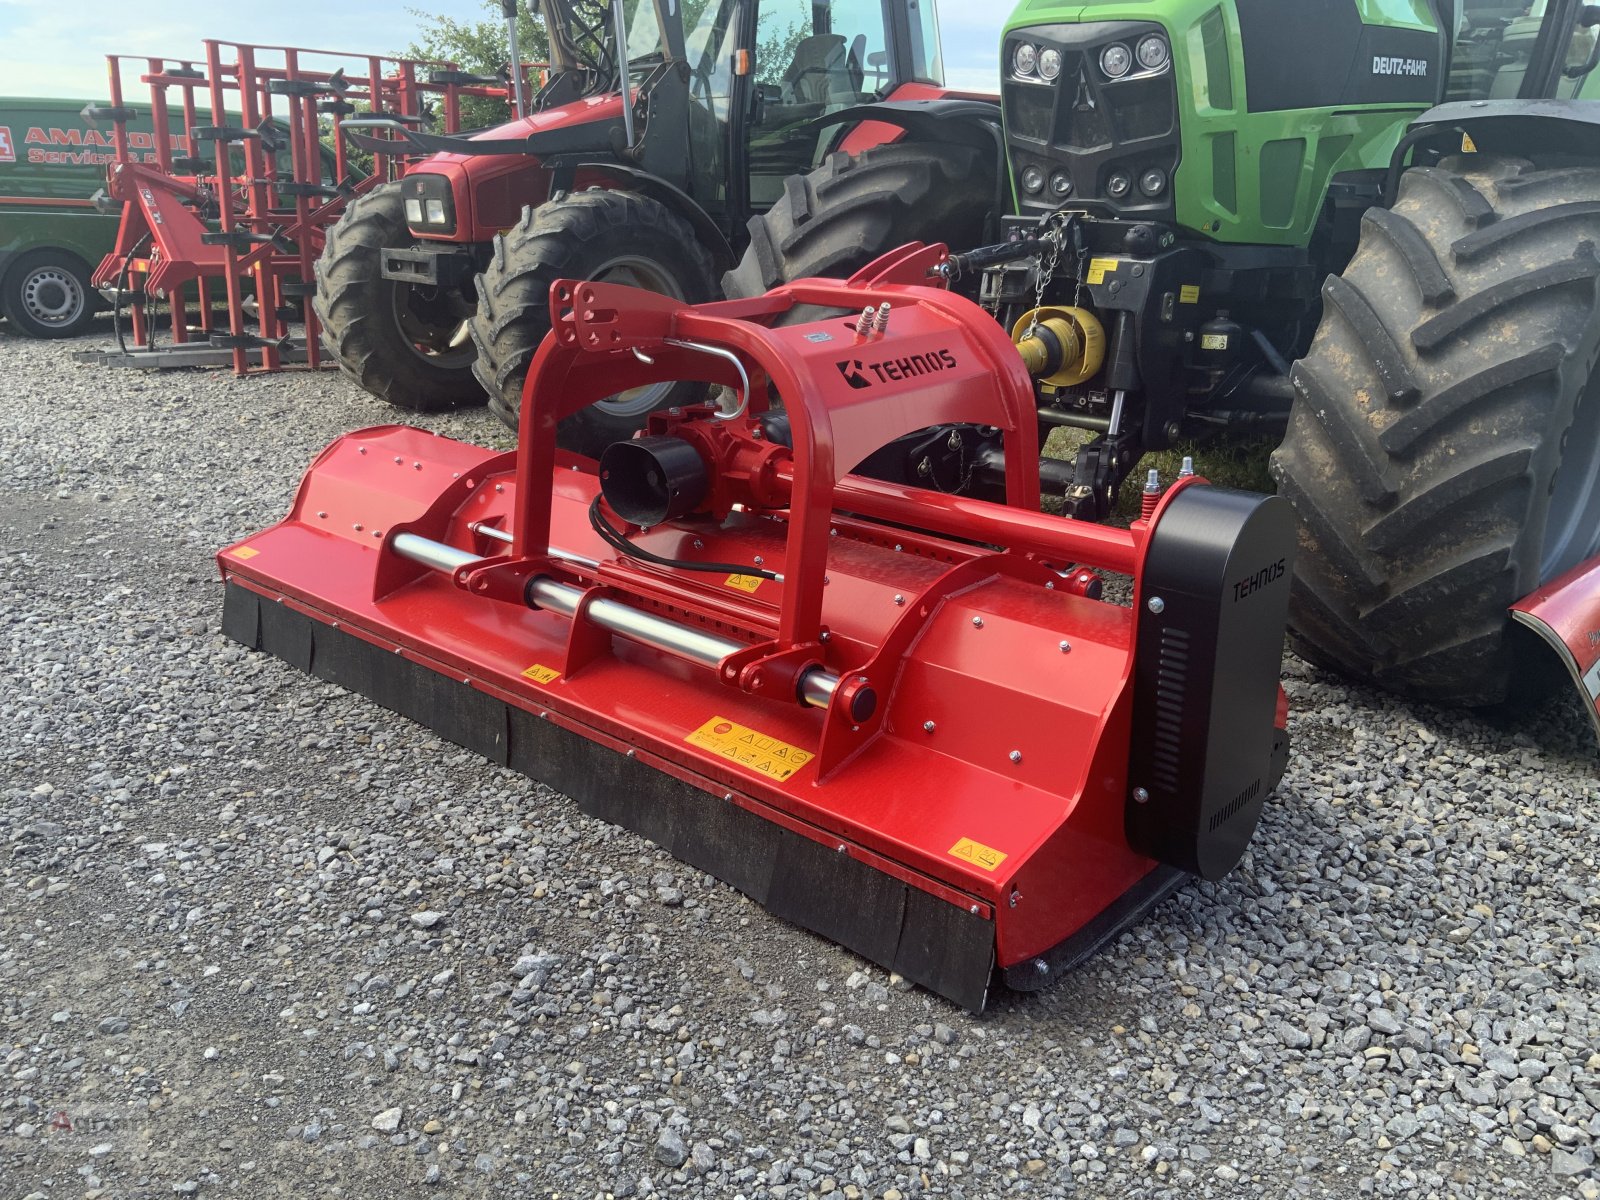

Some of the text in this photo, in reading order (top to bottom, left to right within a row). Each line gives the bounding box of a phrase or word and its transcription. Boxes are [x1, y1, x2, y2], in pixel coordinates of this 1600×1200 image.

[1373, 56, 1427, 76] DEUTZ-FAHR
[27, 148, 118, 165] Service
[869, 349, 957, 384] TEHNOS
[1233, 558, 1285, 602] TEHNOS
